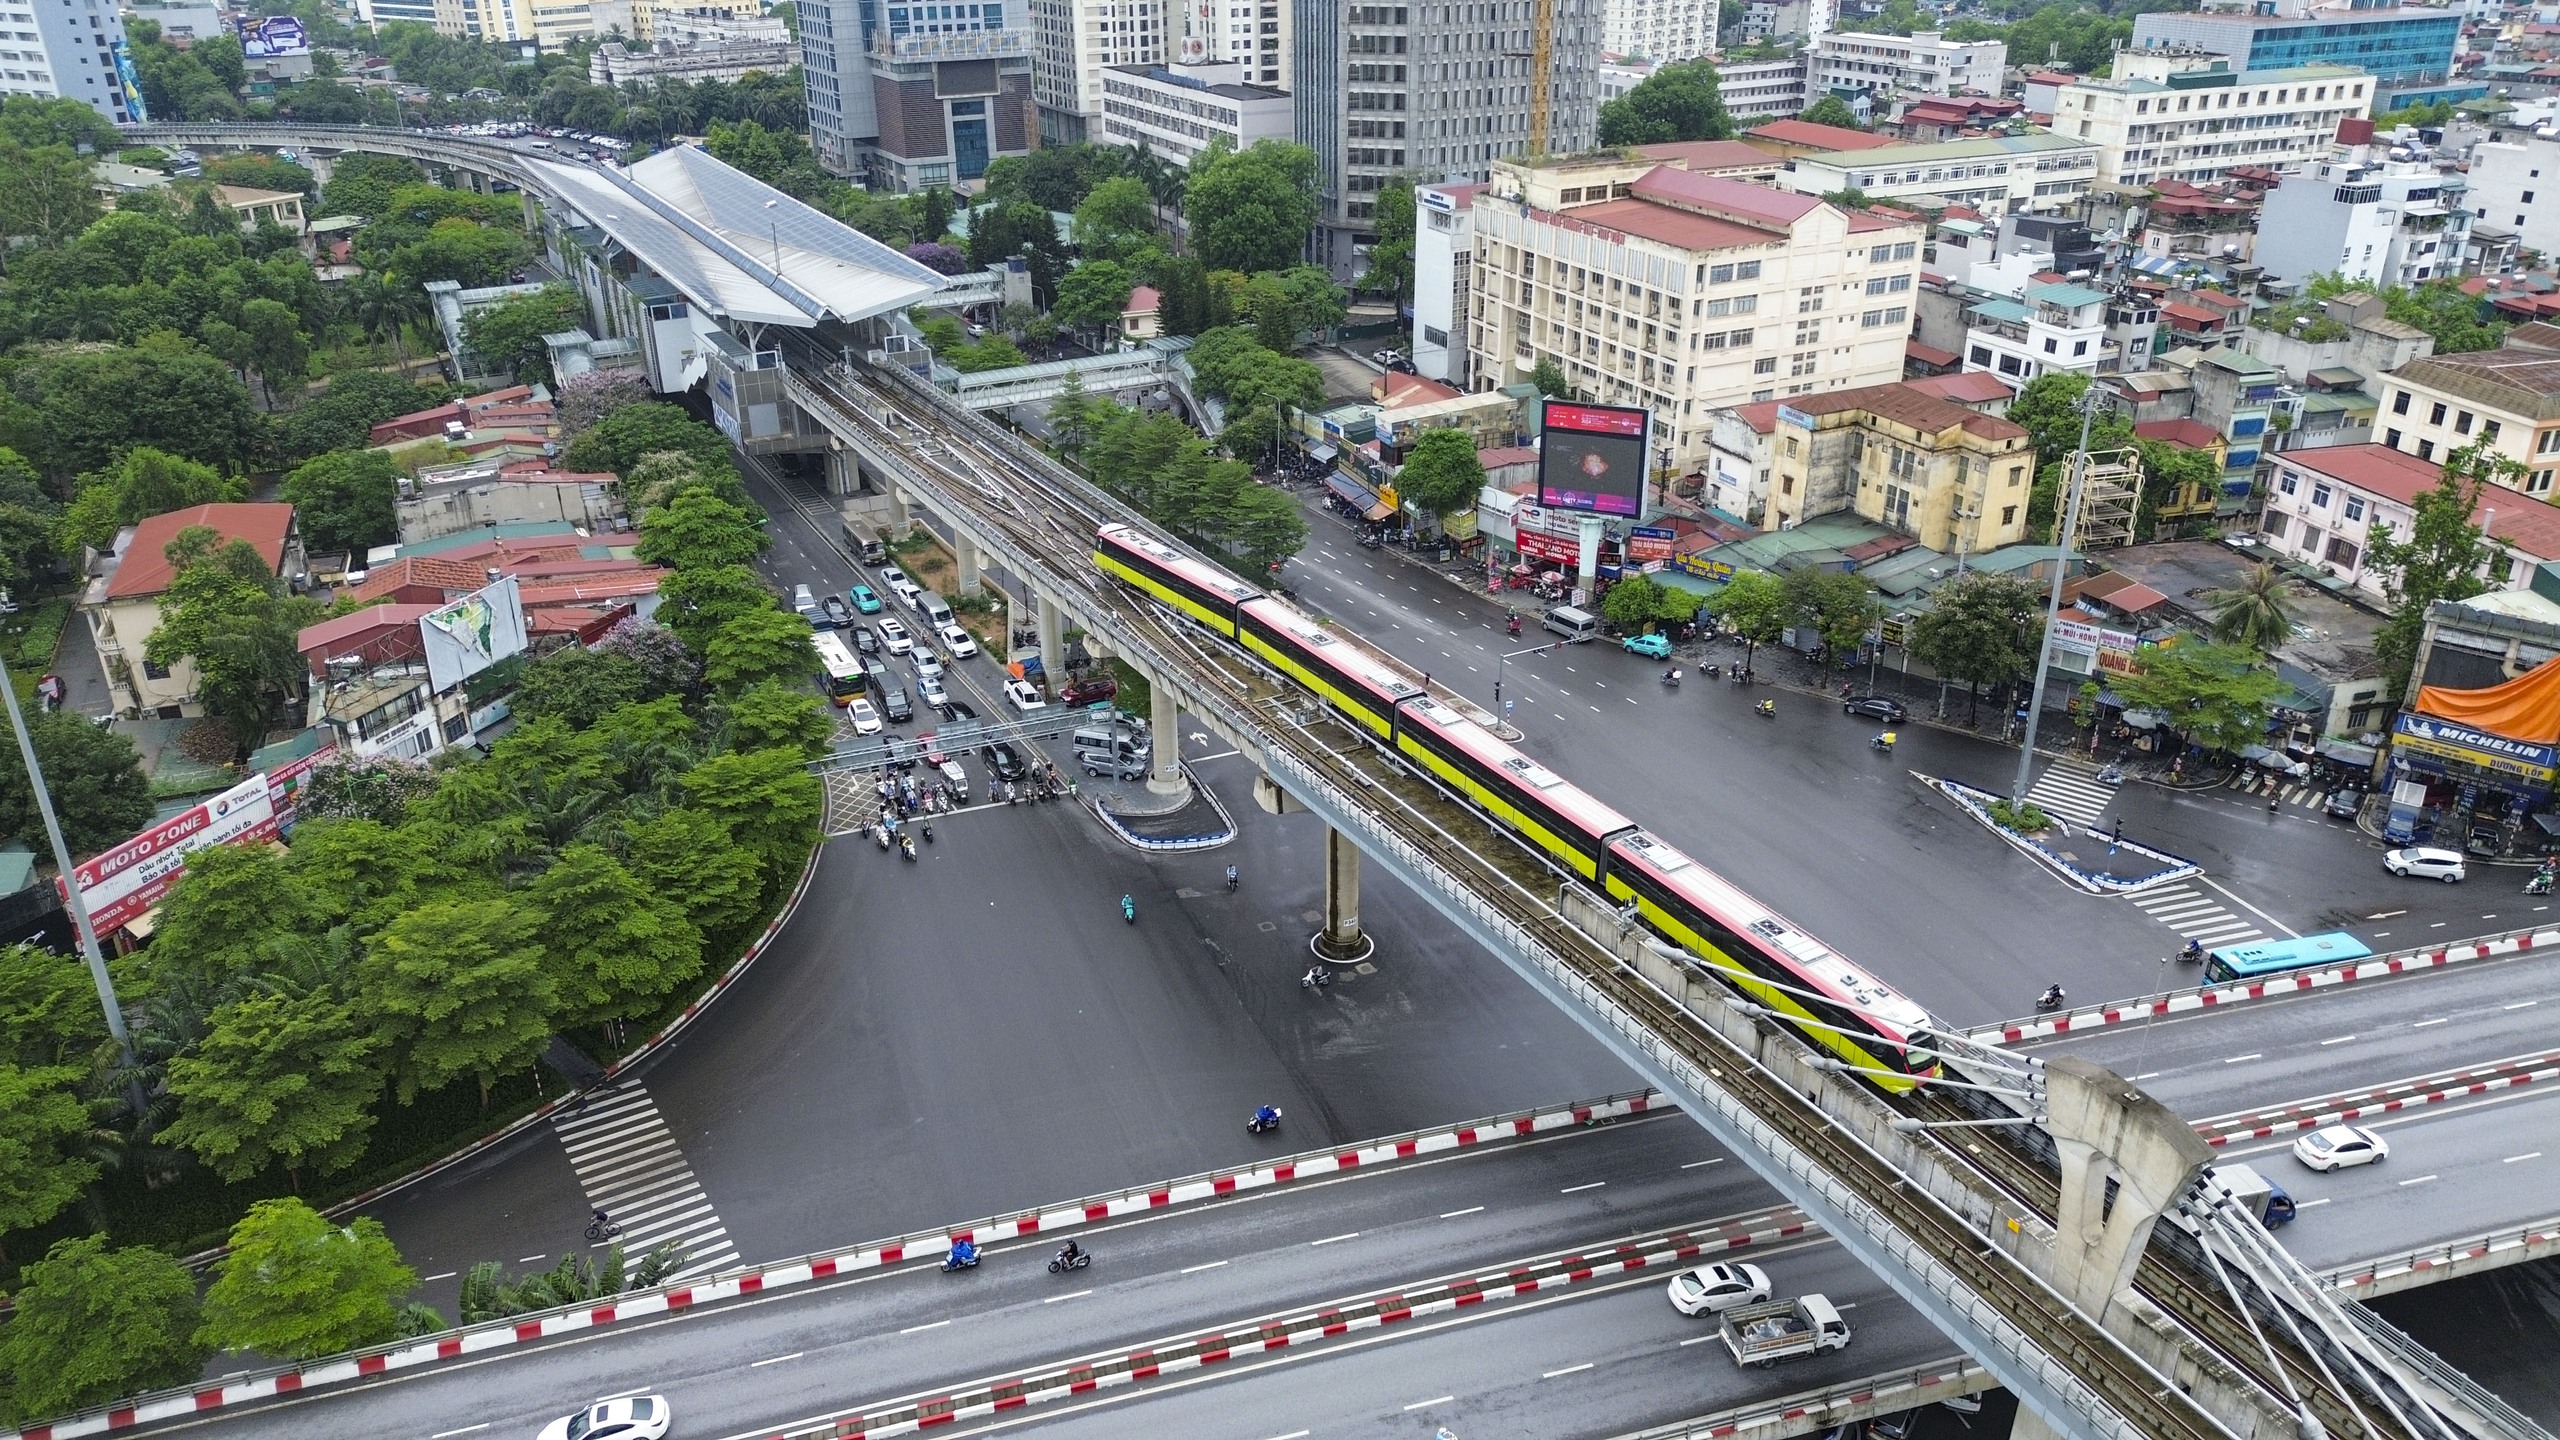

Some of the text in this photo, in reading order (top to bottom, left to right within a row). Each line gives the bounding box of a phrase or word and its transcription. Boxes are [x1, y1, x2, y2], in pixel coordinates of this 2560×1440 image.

[1547, 513, 1567, 524] moto
[1545, 552, 1568, 561] HONDA
[2098, 650, 2126, 672] QUẢNG
[2437, 727, 2542, 758] MICHELIN
[2525, 764, 2544, 778] LỐP
[231, 788, 263, 805] TOTAL
[100, 813, 202, 876] MOTO ZONE
[141, 871, 158, 884] Bảo
[159, 864, 170, 875] vệ
[213, 830, 231, 846] hành
[231, 822, 242, 835] tối
[242, 820, 252, 830] đa
[138, 839, 196, 874] Dầu nhớt Total
[138, 883, 165, 901] YAMAHA
[92, 905, 125, 927] HONDA
